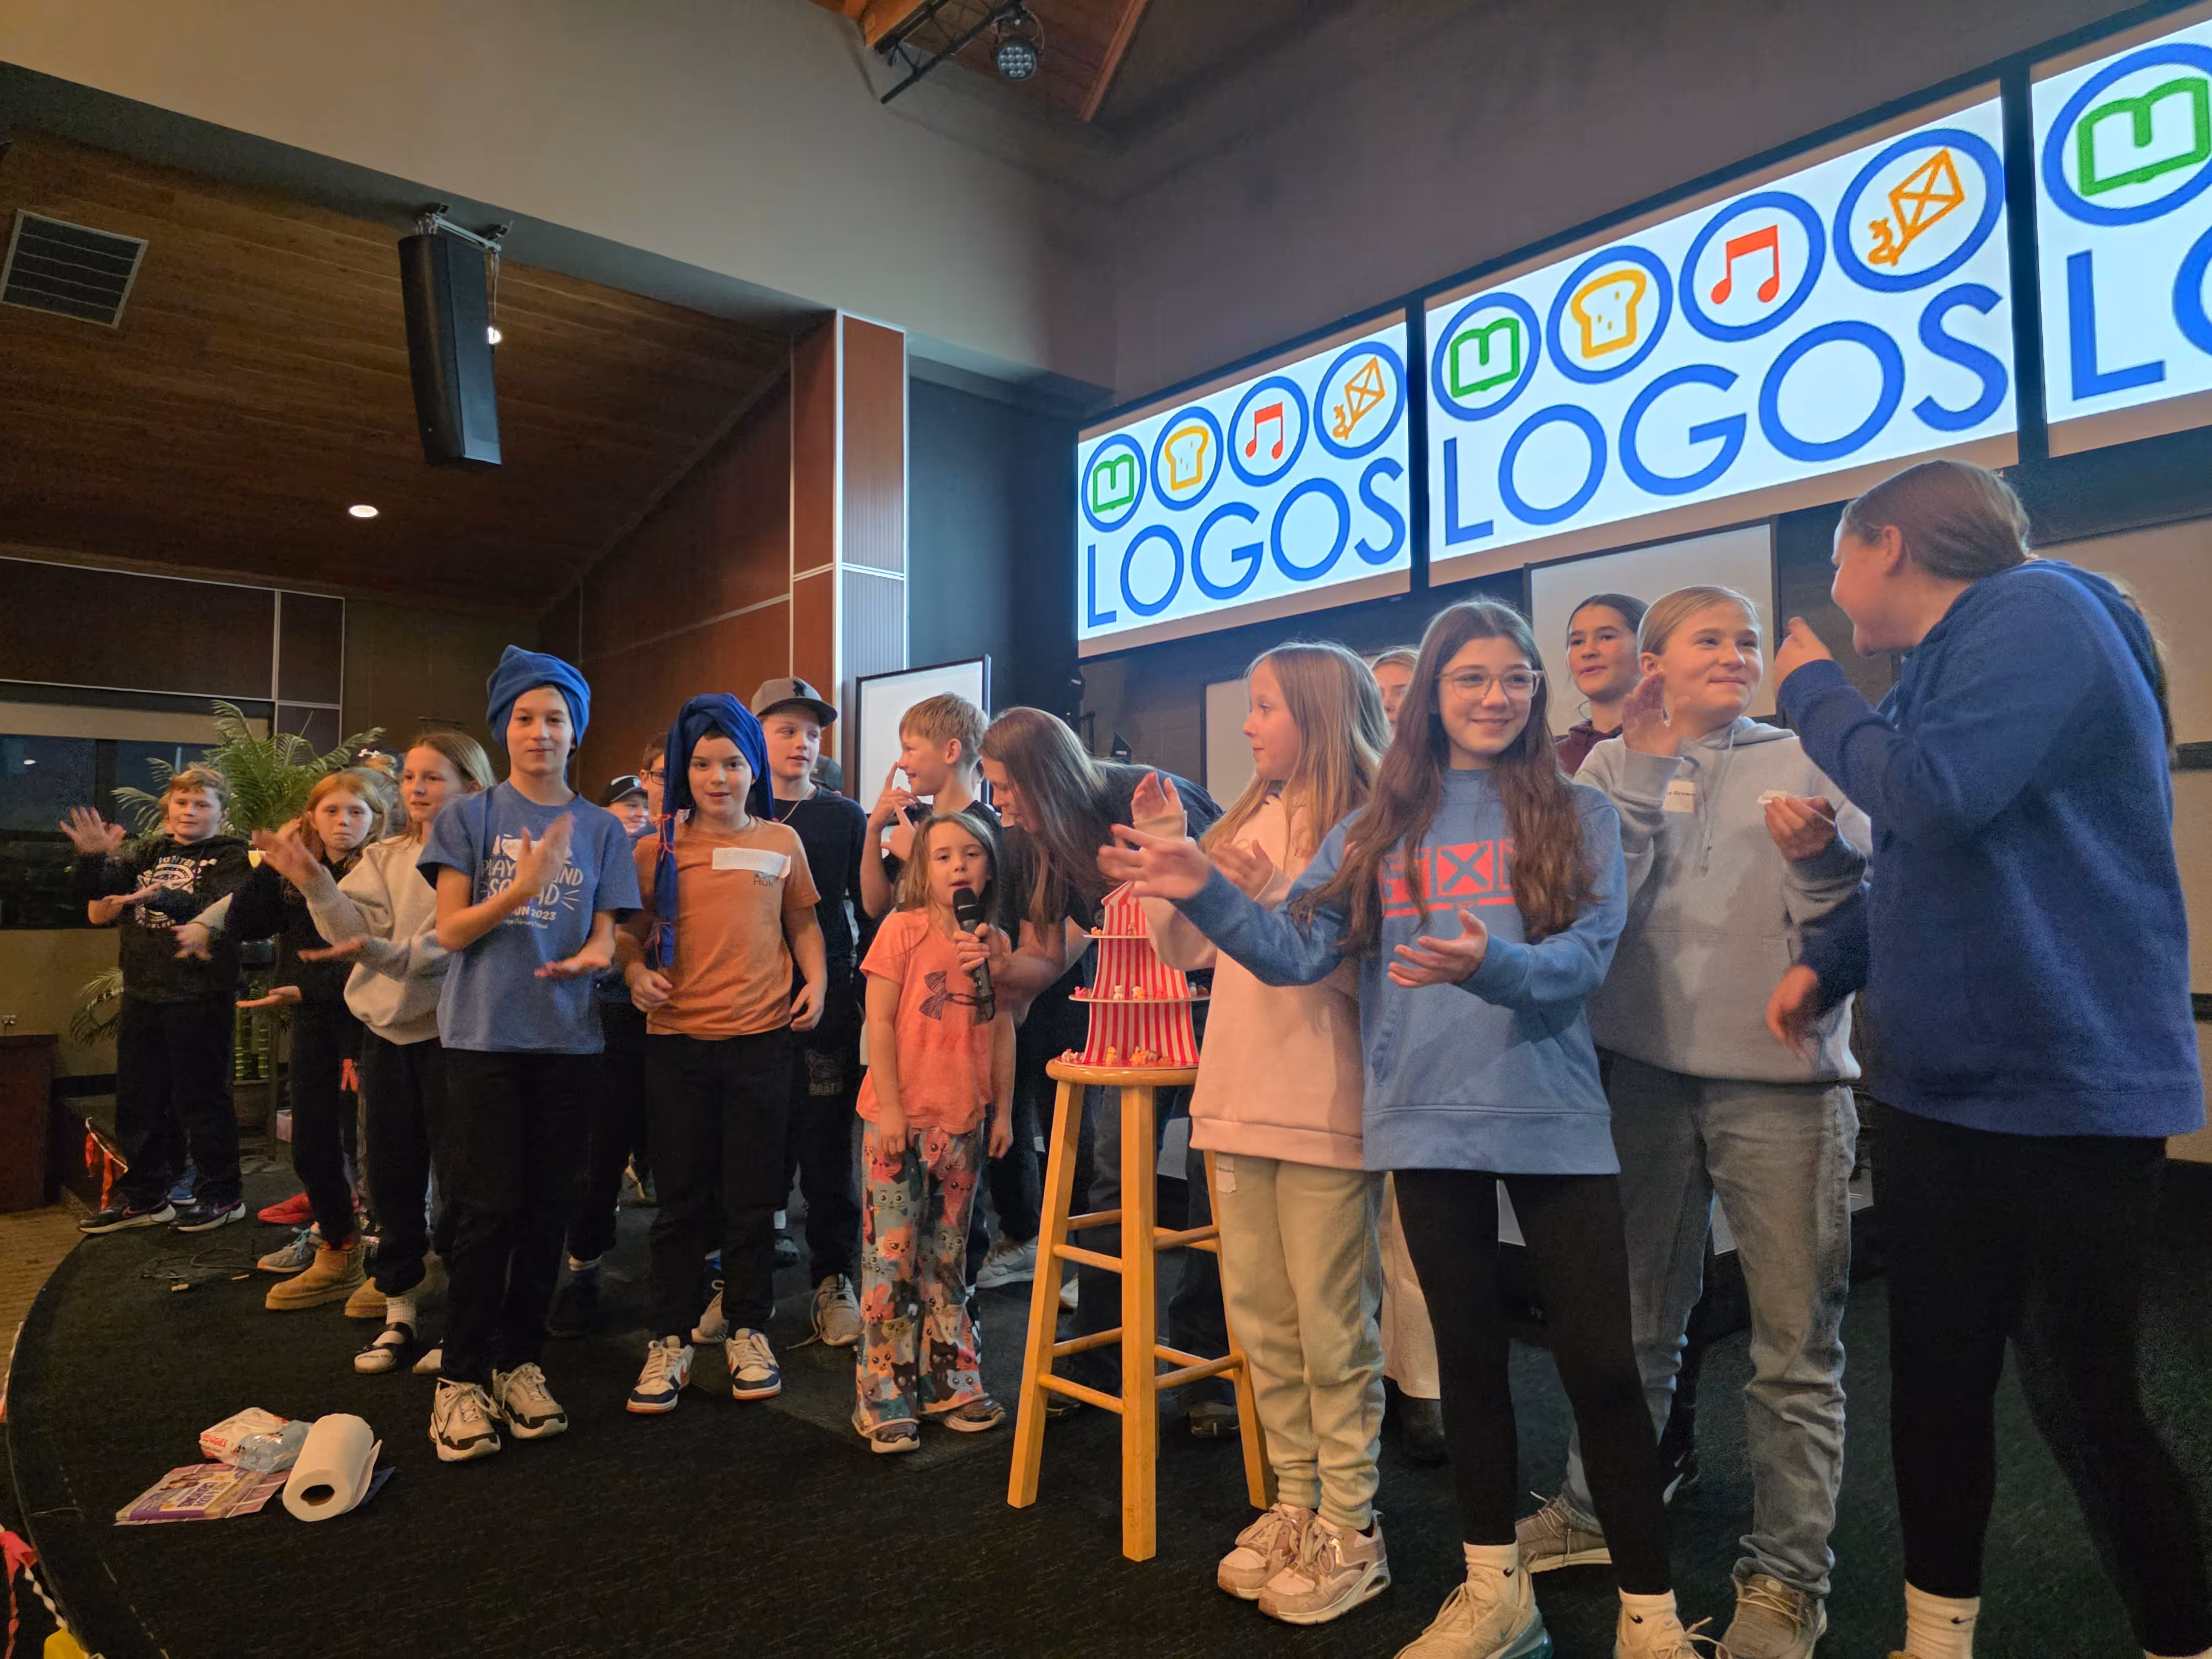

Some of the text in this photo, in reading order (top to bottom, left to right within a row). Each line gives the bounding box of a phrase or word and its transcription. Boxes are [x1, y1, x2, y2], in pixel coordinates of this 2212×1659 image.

[1443, 281, 2010, 547] LOGOS
[1087, 456, 1407, 629] LOGOS
[483, 858, 584, 886] PLAYND
[487, 878, 560, 906] SQD
[512, 906, 557, 921] UN 2023
